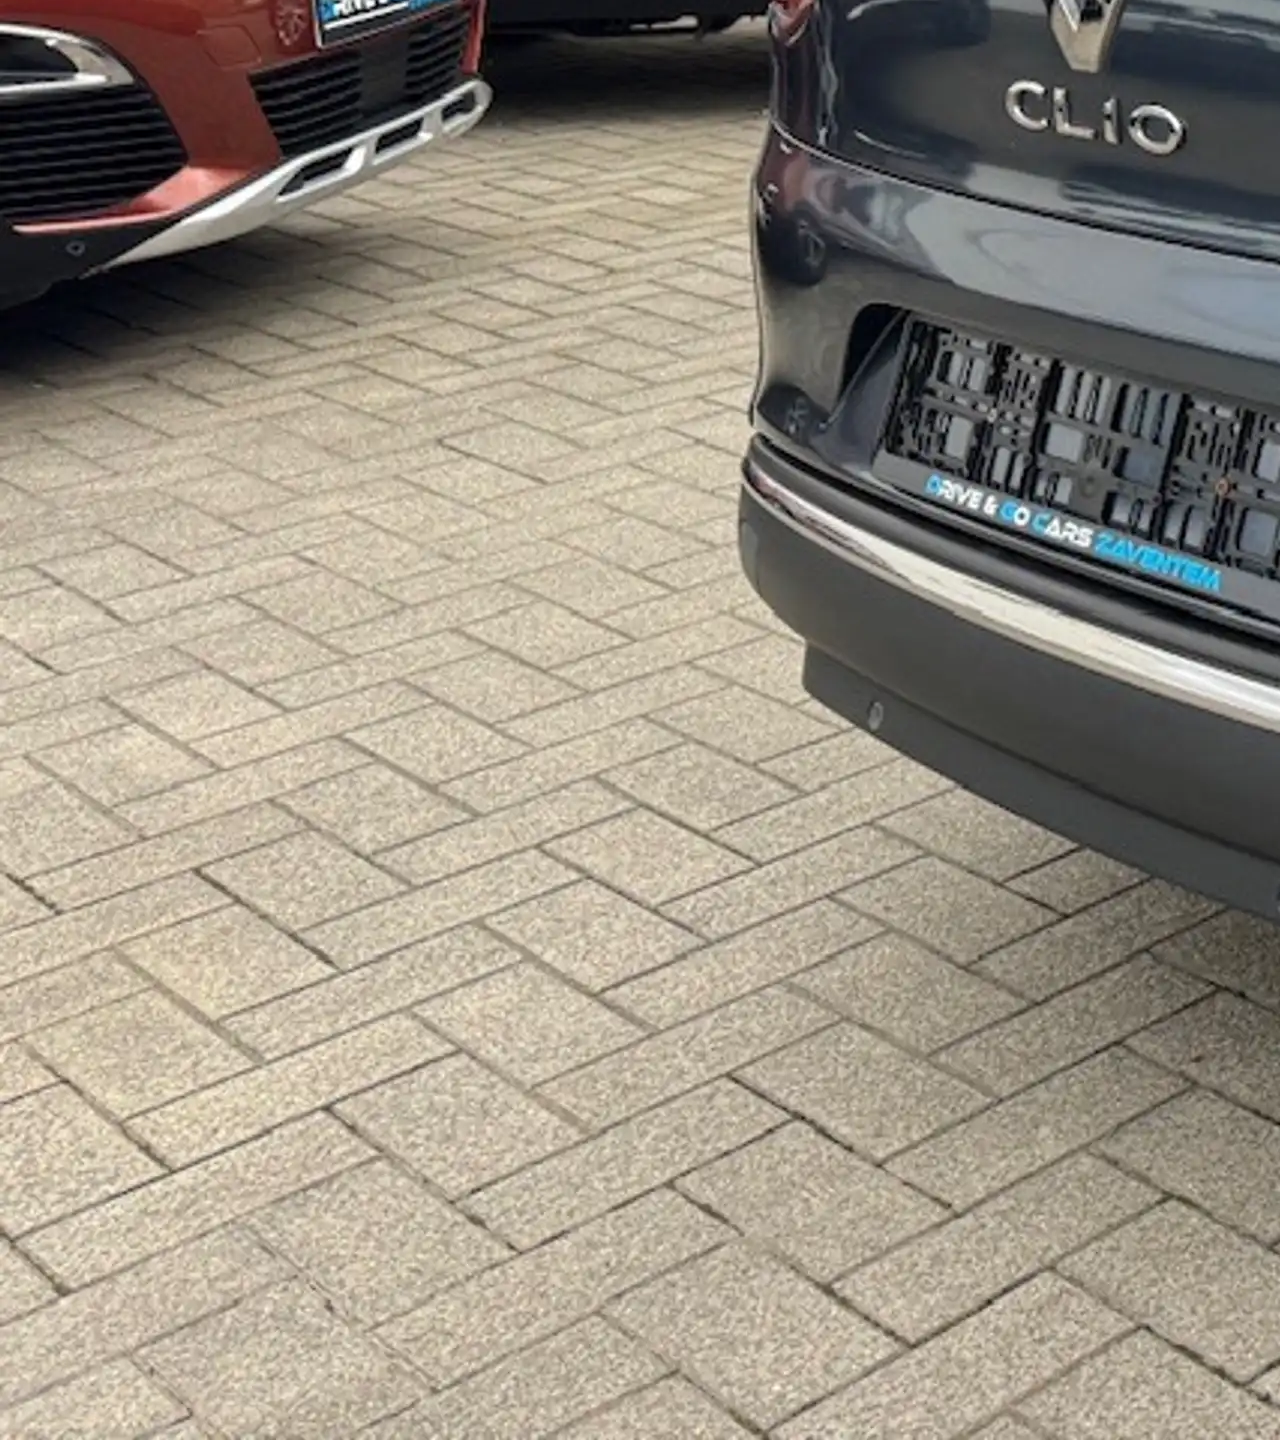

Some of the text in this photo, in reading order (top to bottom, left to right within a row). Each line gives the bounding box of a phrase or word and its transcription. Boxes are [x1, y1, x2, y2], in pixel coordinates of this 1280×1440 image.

[1004, 79, 1188, 156] CLIO
[925, 473, 1223, 593] DRIVE & GO CARS ZAVENTEM
